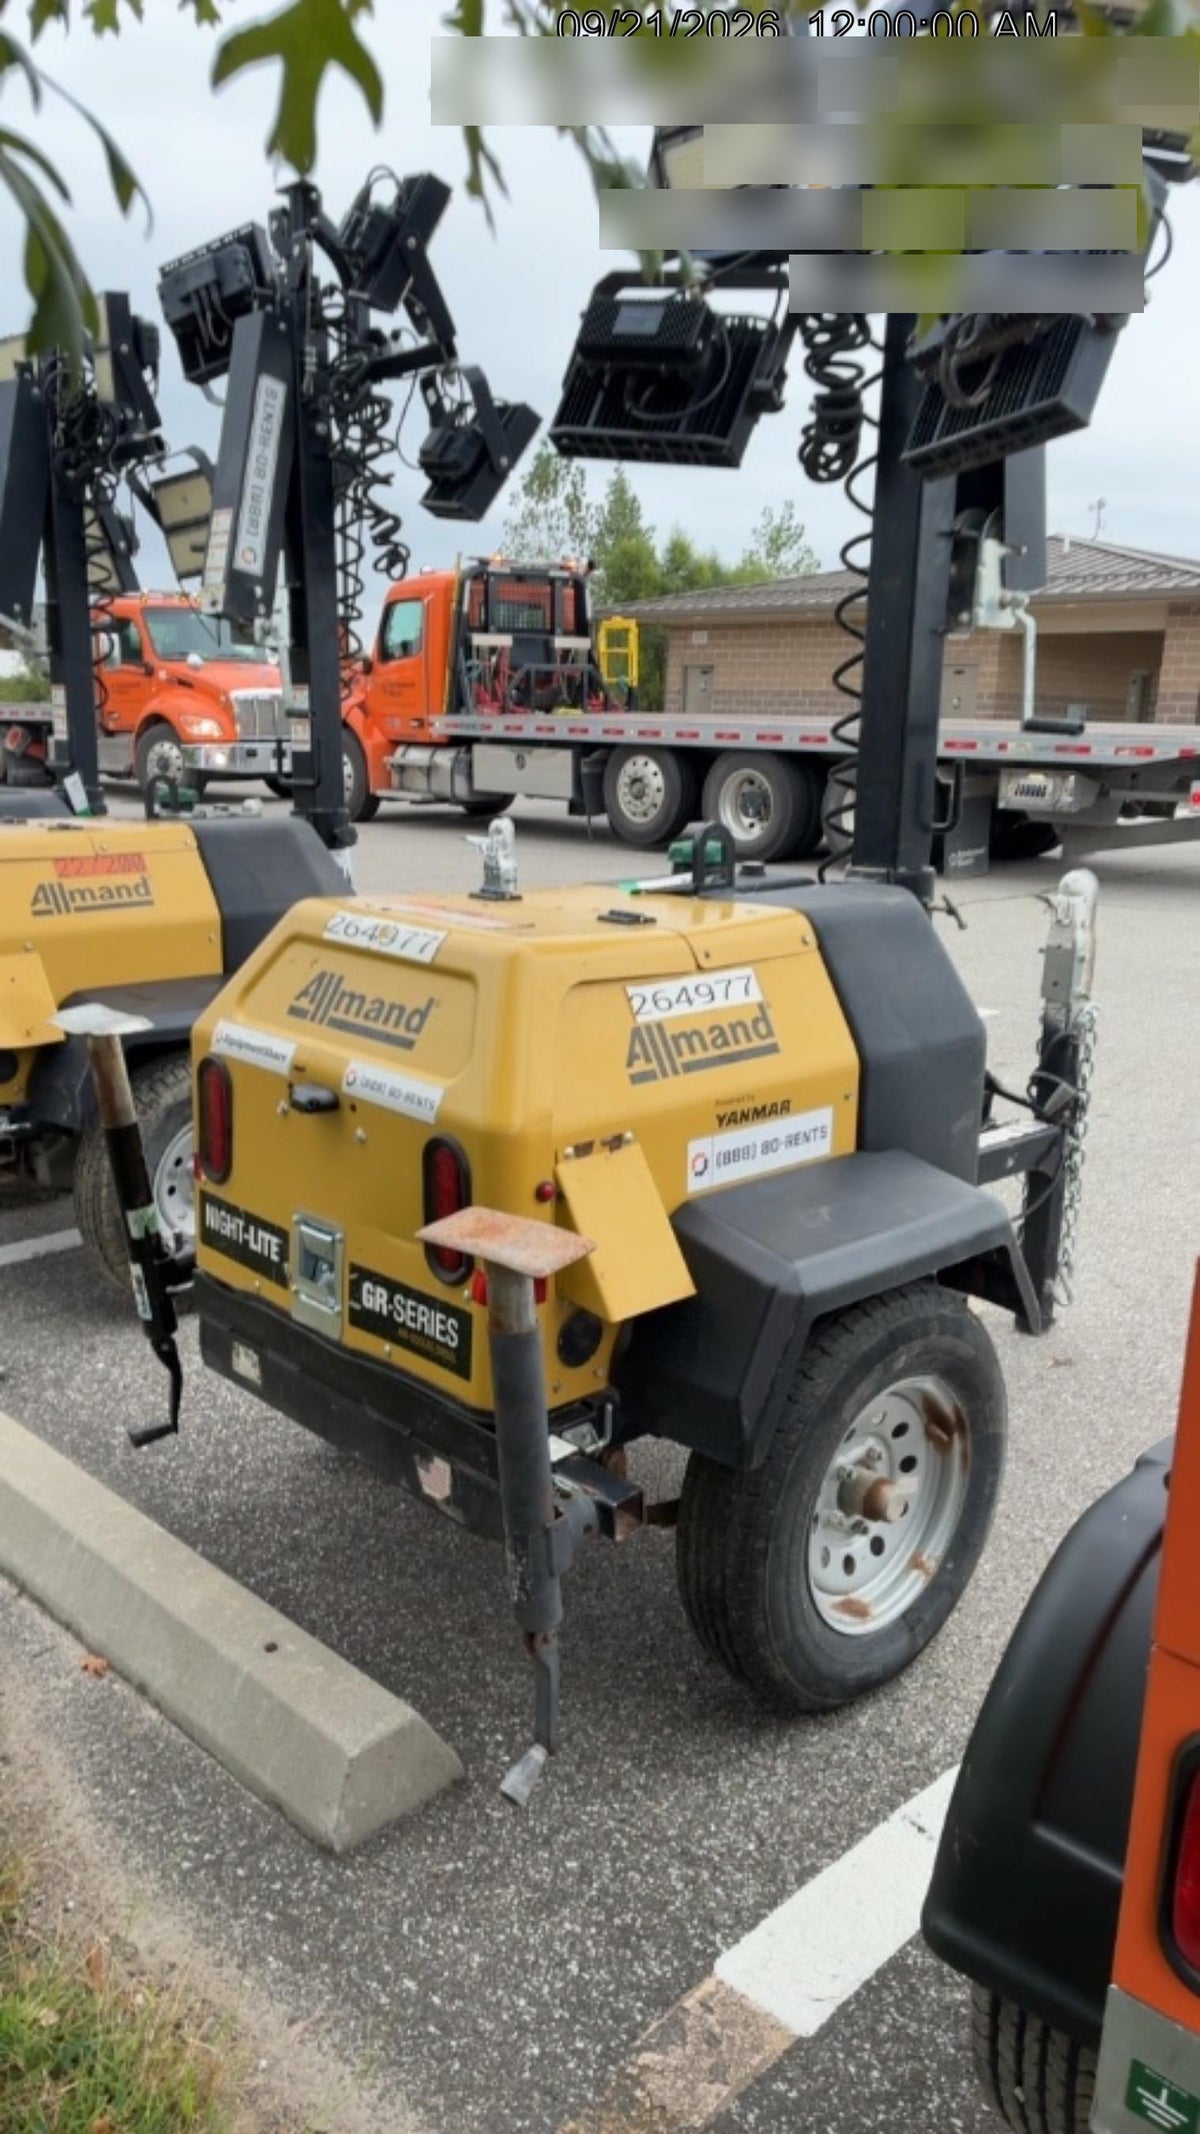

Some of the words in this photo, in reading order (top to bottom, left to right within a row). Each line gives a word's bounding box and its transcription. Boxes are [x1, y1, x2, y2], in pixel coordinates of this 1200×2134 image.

[31, 875, 152, 915] Allmand
[325, 916, 441, 955] 264977
[292, 970, 436, 1036] Allmand
[629, 974, 752, 1016] 264977
[626, 1001, 776, 1080] Allmand
[715, 1099, 792, 1129] YANMAR
[716, 1141, 757, 1169] (888)
[760, 1125, 829, 1156] 80-RENTS
[205, 1202, 281, 1263] NIGHT-LITE
[361, 1281, 459, 1349] GR-SERIES
